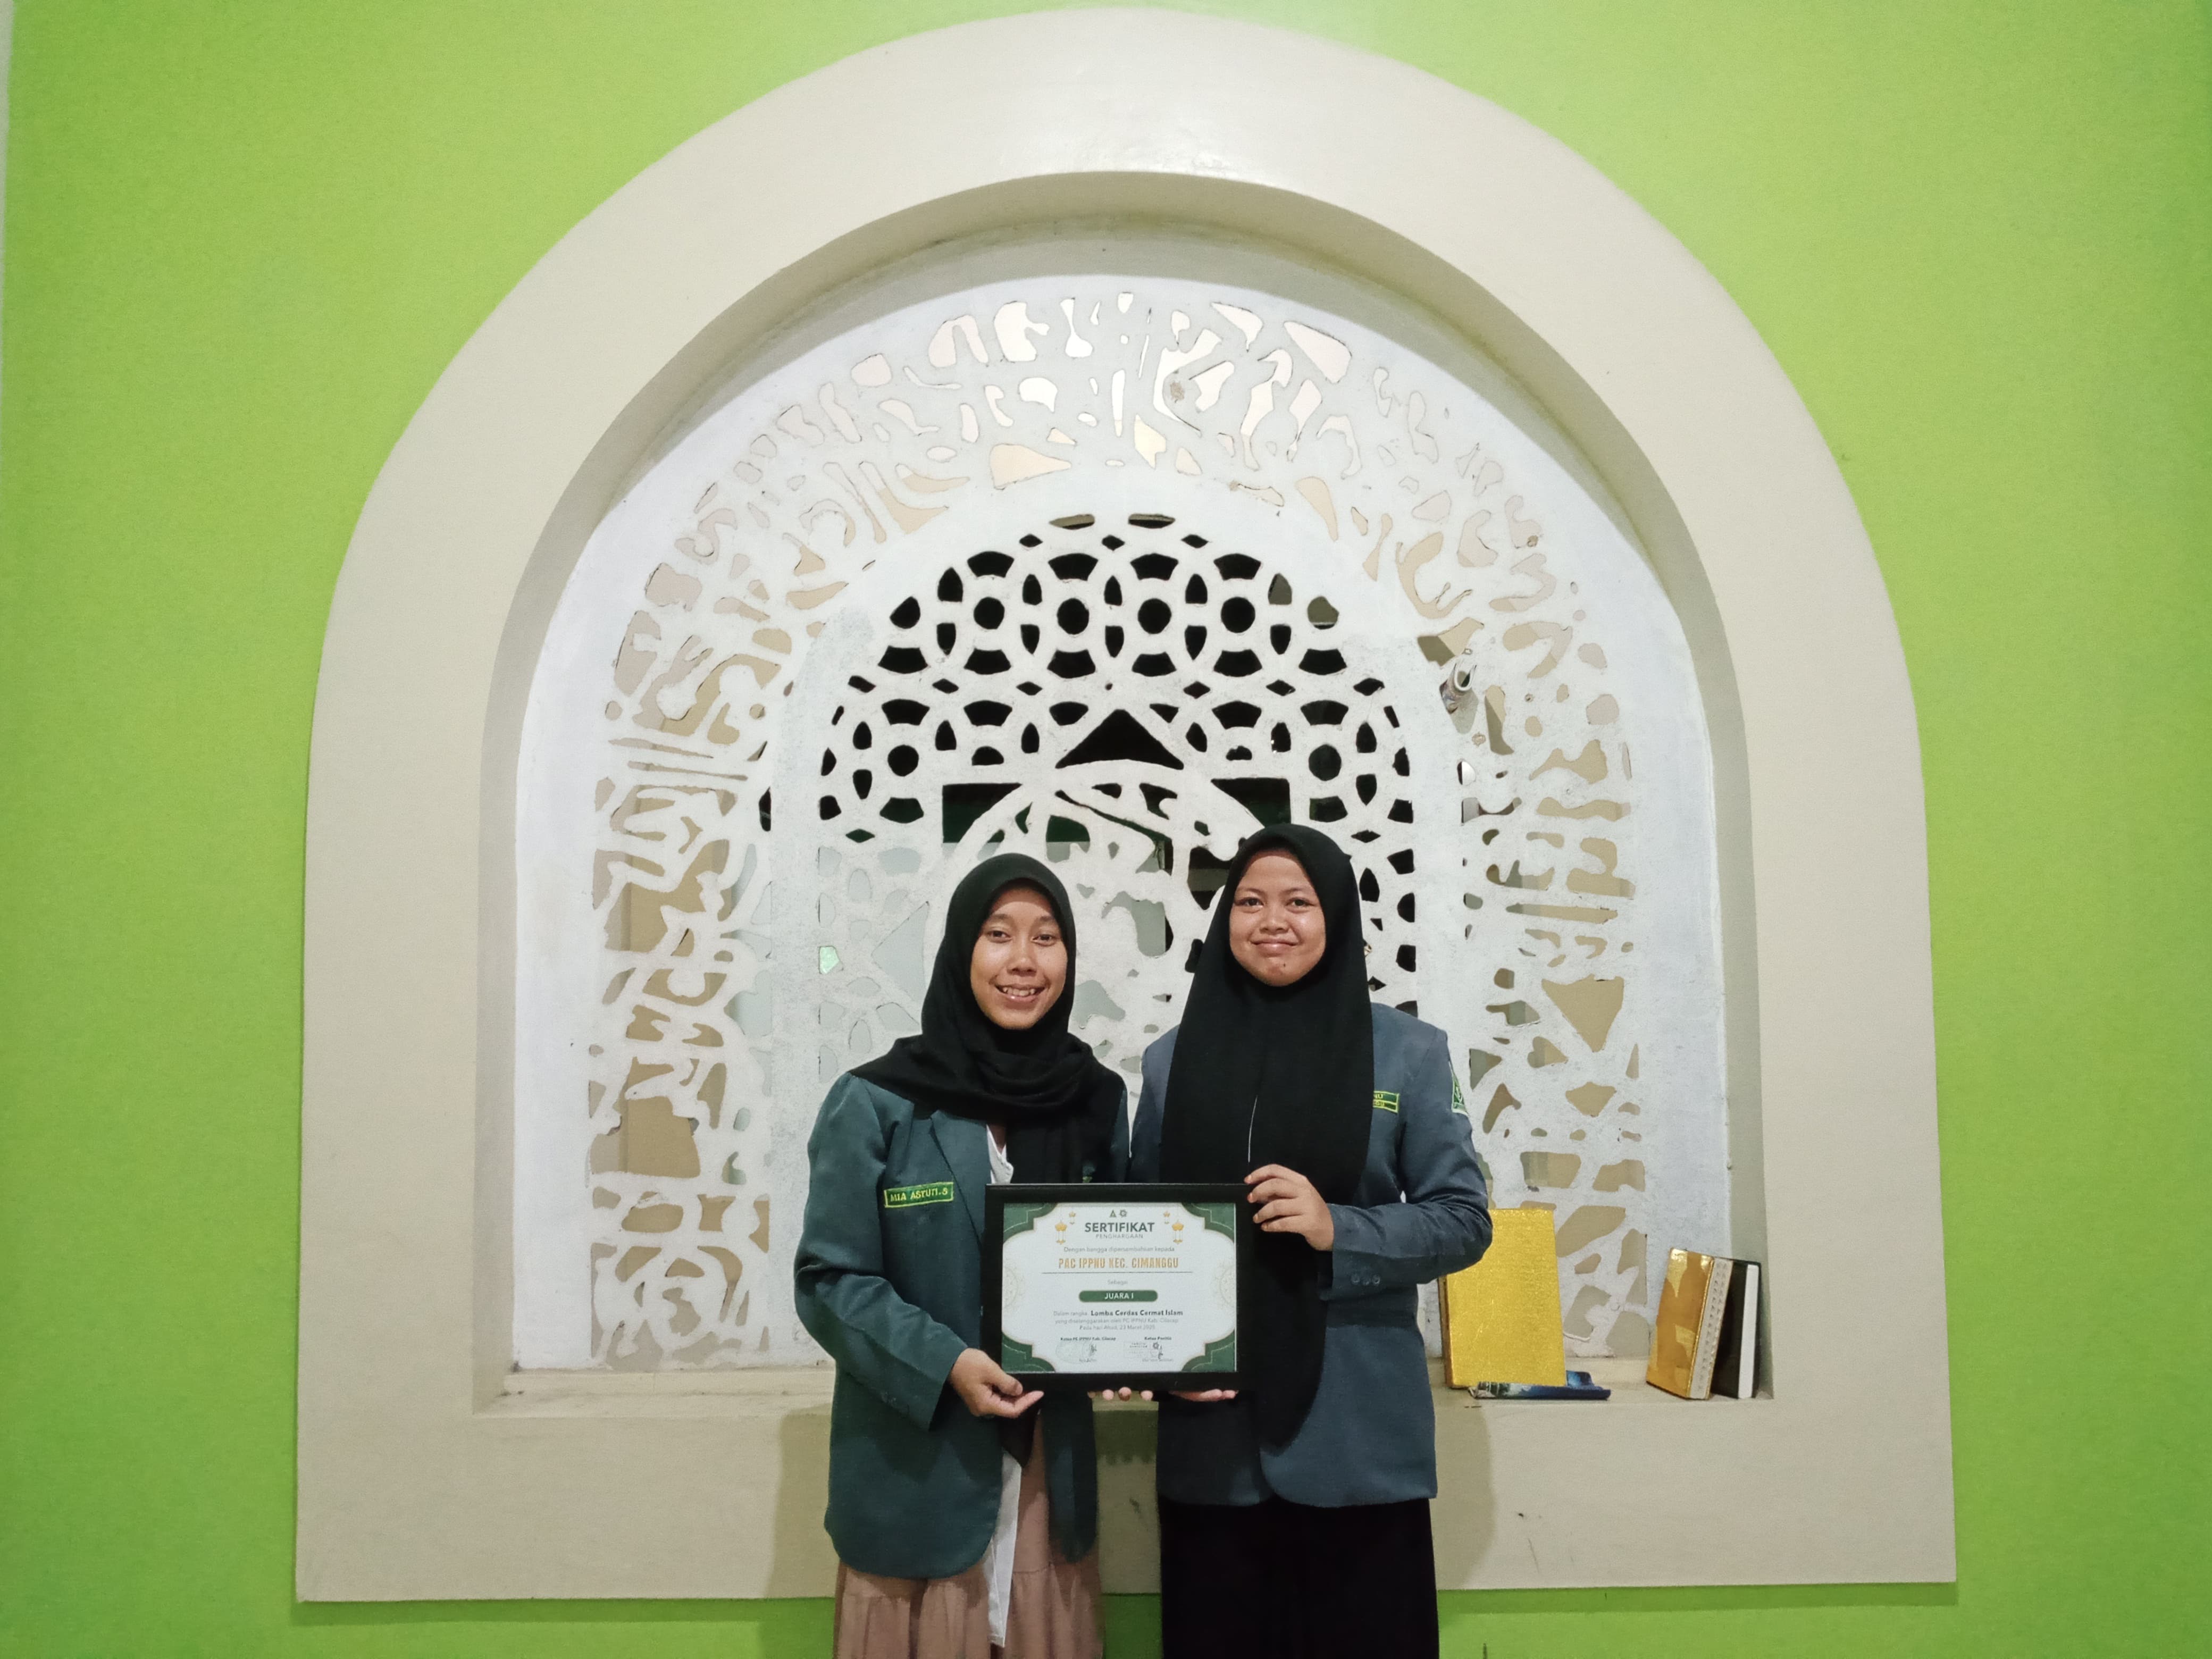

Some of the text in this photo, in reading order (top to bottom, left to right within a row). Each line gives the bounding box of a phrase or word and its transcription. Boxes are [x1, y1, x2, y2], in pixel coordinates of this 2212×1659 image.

[890, 1192, 907, 1202] MIA
[1085, 1222, 1155, 1233] SERTIFIKAT
[1059, 1257, 1179, 1269] PAC IPPNU KEC. CIMANGGU
